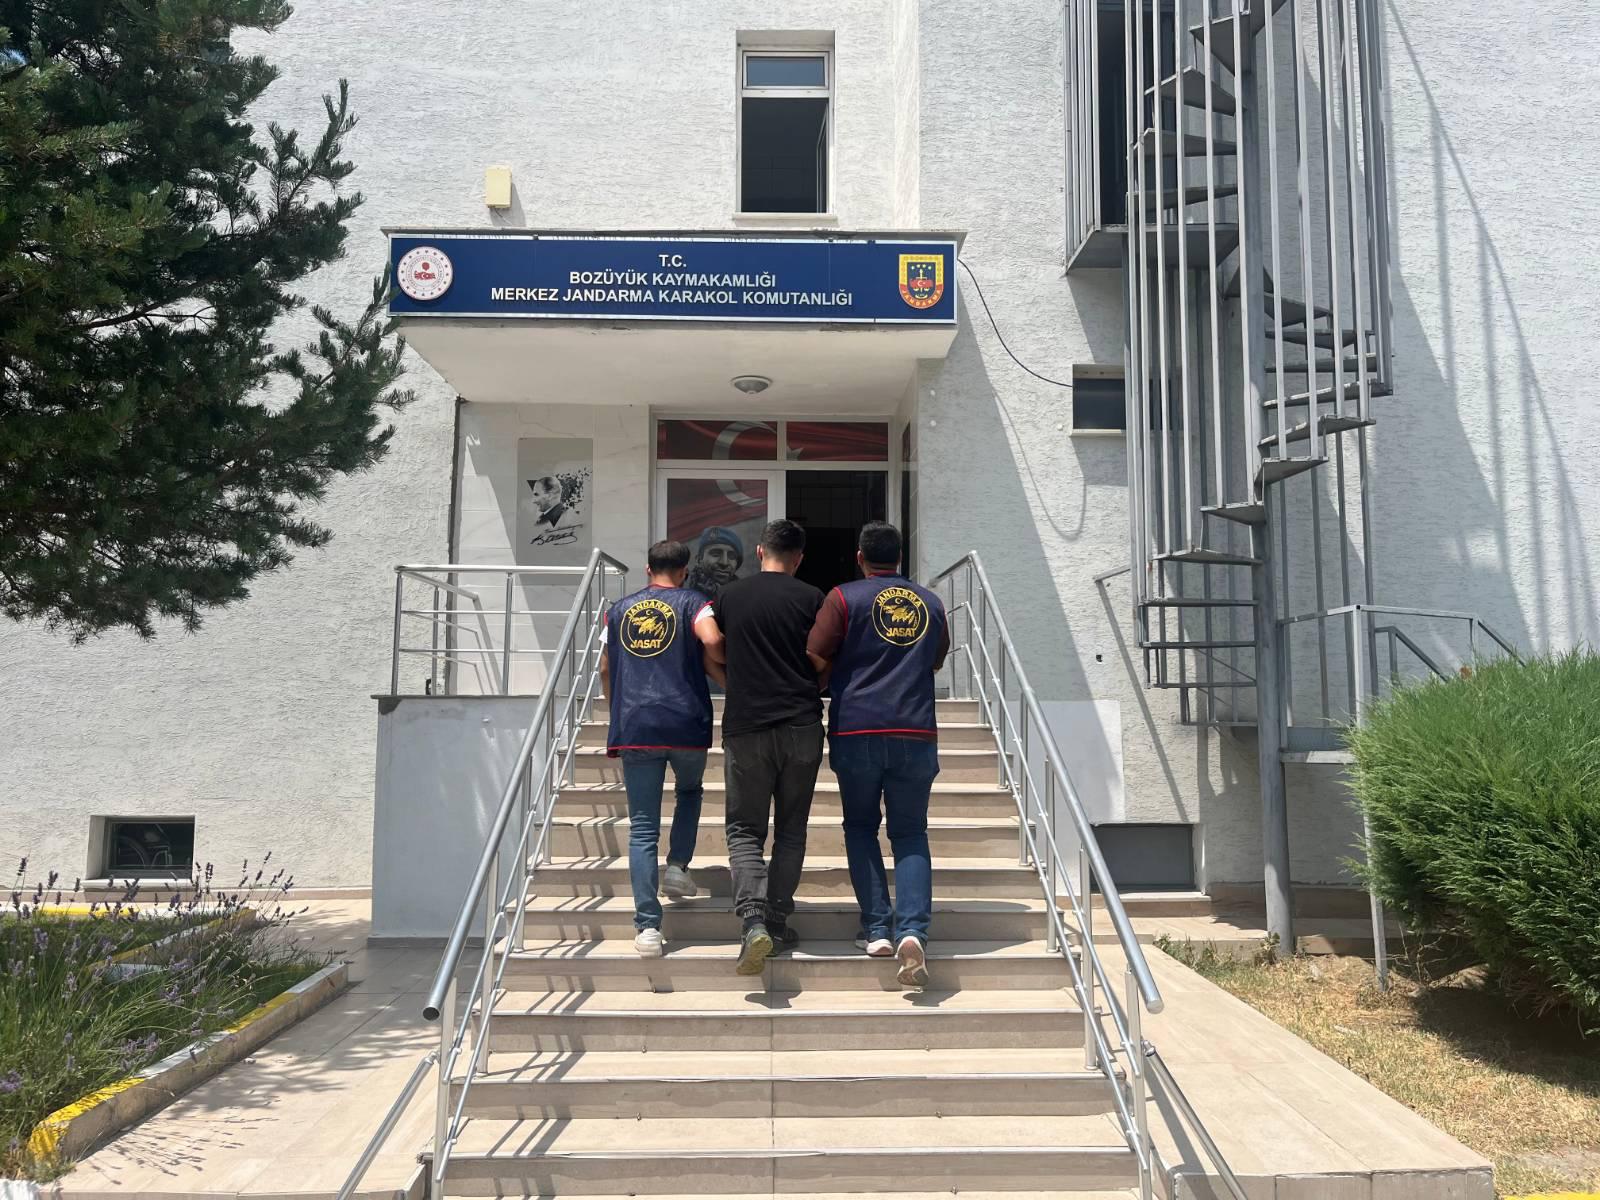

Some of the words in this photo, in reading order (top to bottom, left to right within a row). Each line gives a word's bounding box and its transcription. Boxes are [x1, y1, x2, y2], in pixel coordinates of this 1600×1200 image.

[659, 254, 687, 267] T.C.
[570, 269, 648, 285] BOZÜYÜK
[652, 271, 776, 287] KAYMAKAMLIĞI
[491, 287, 559, 301] MERKEZ
[562, 288, 655, 303] JANDARMA
[659, 290, 737, 304] KARAKOL
[743, 289, 853, 306] KOMUTANLIĞI
[876, 589, 922, 608] JANDARMA
[626, 600, 672, 620] JANDARMA
[886, 627, 916, 637] JASAT
[630, 639, 662, 649] JASAT
